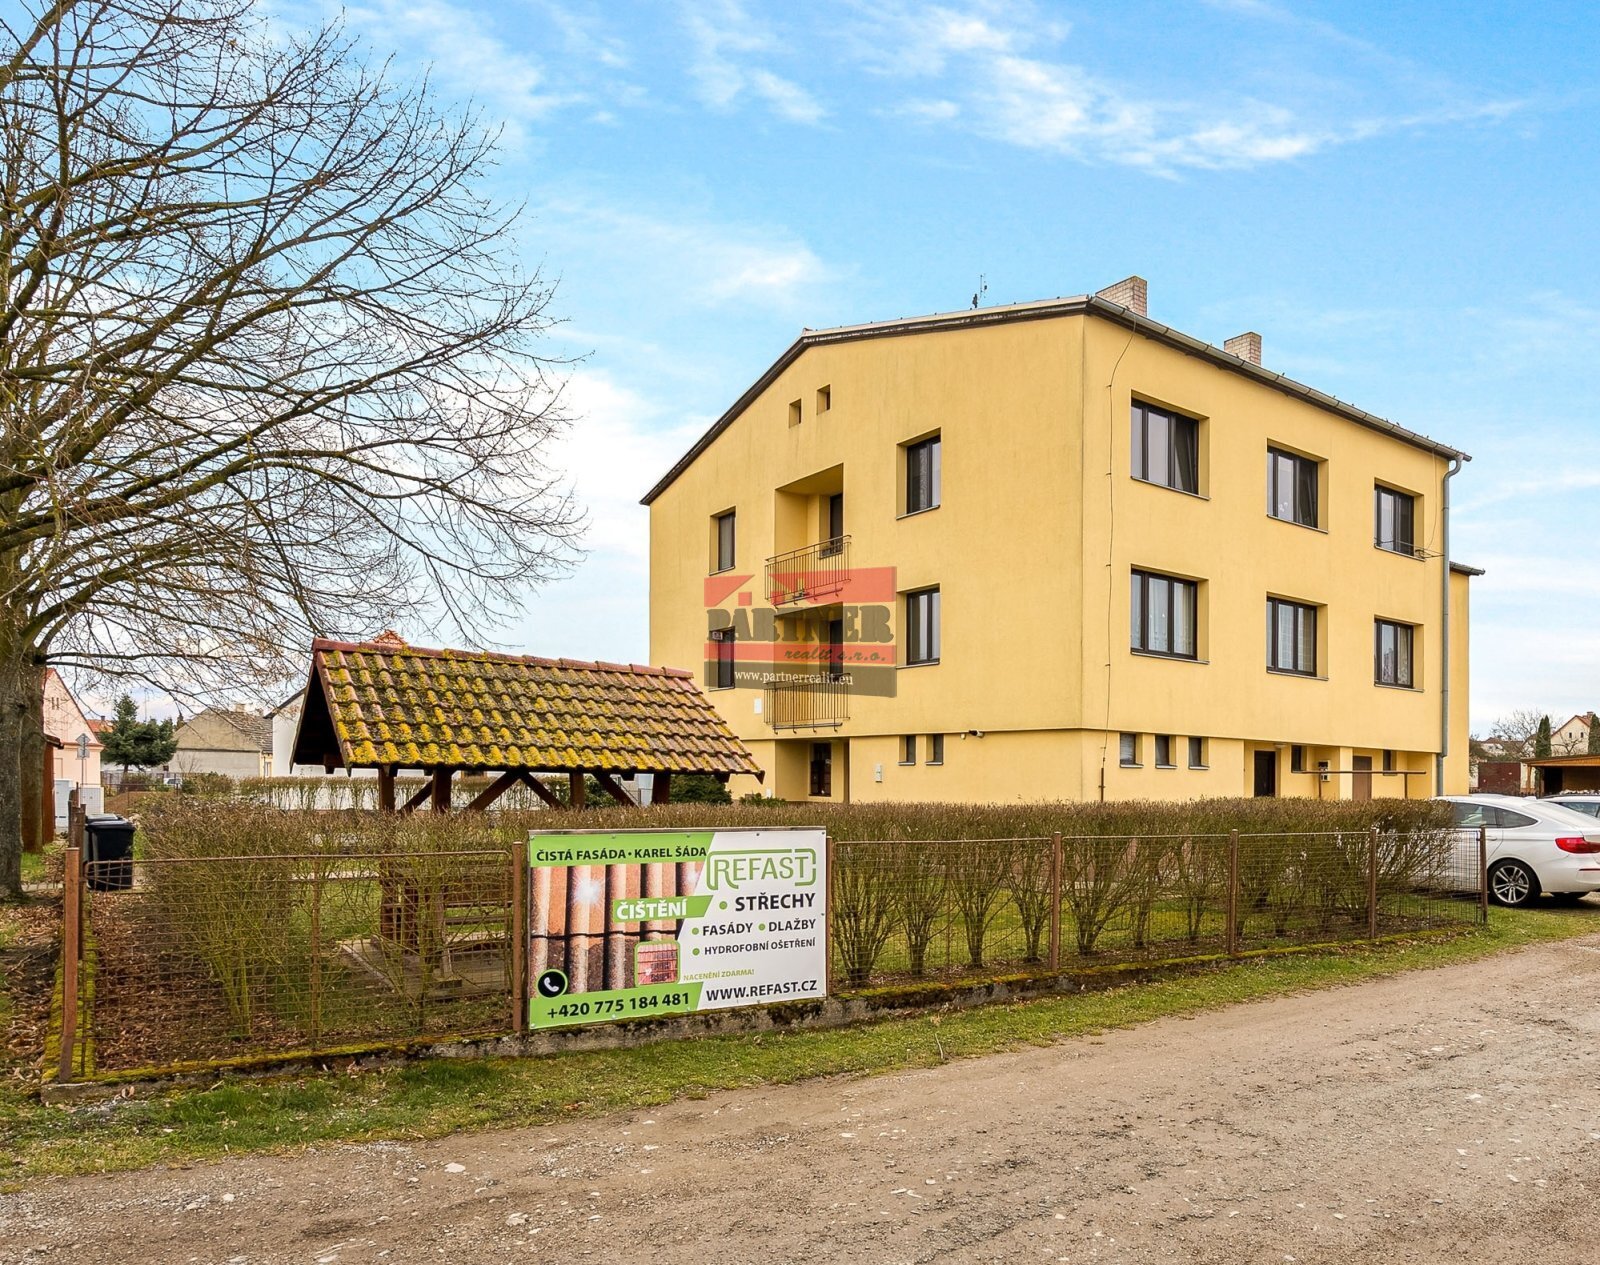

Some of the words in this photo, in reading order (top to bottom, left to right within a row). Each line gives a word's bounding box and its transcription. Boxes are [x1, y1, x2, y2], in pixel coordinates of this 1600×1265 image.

[536, 849, 572, 861] ČISTÁ
[576, 848, 626, 860] FASÁDA
[634, 848, 673, 858] KAREL
[675, 846, 706, 857] ŠÁDA
[706, 848, 816, 890] REFAST
[616, 899, 688, 920] ČIŠTĚNÍ
[735, 892, 816, 912] STŘECHY
[702, 922, 753, 936] FASÁDY
[768, 918, 816, 932] DLAŽBY
[704, 940, 769, 956] HYDROFOBNÍ
[771, 937, 816, 950] OŠETŘENÍ
[683, 971, 720, 981] NACENĚNÍ
[721, 969, 754, 978] ZDARMA!
[706, 980, 817, 1002] WWW.REFAST.CZ
[548, 1002, 590, 1018] +420
[594, 998, 624, 1013] 775
[629, 994, 658, 1010] 184
[662, 992, 689, 1007] 481
